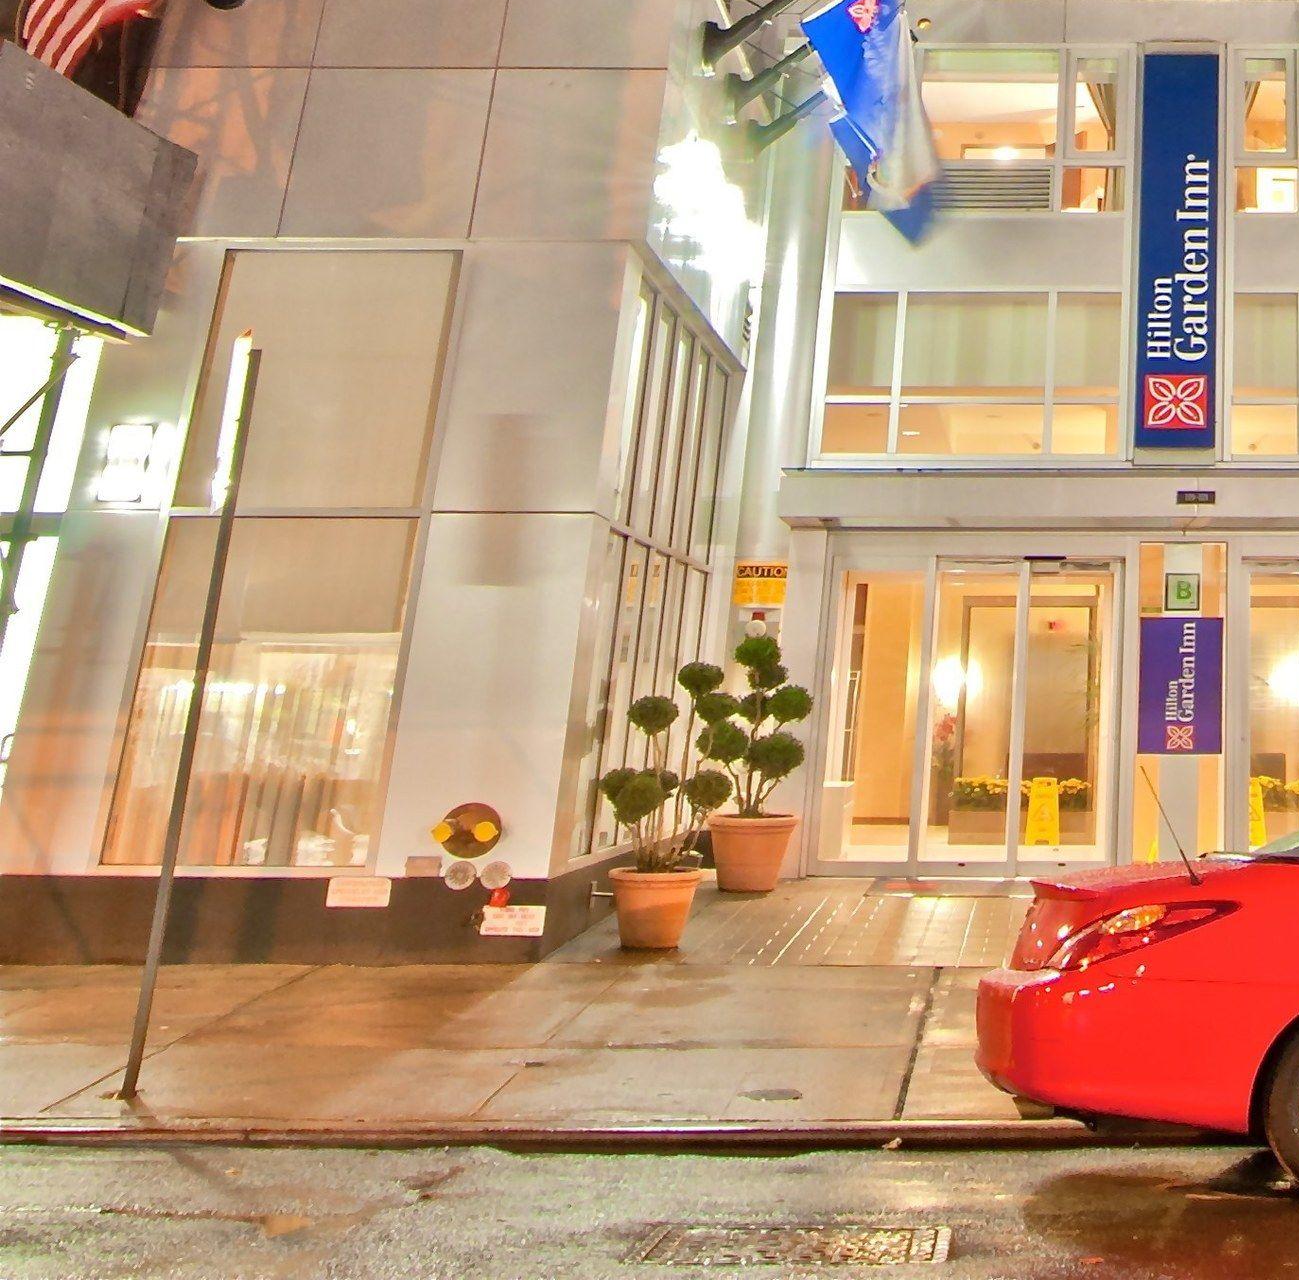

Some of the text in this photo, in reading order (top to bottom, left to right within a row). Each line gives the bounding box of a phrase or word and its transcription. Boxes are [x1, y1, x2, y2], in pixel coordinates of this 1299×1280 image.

[1173, 159, 1210, 362] Garden Inn
[1147, 277, 1173, 360] Hilton
[1176, 580, 1192, 600] B
[1165, 680, 1178, 721] Hilton
[1178, 622, 1196, 722] Garden Inn
